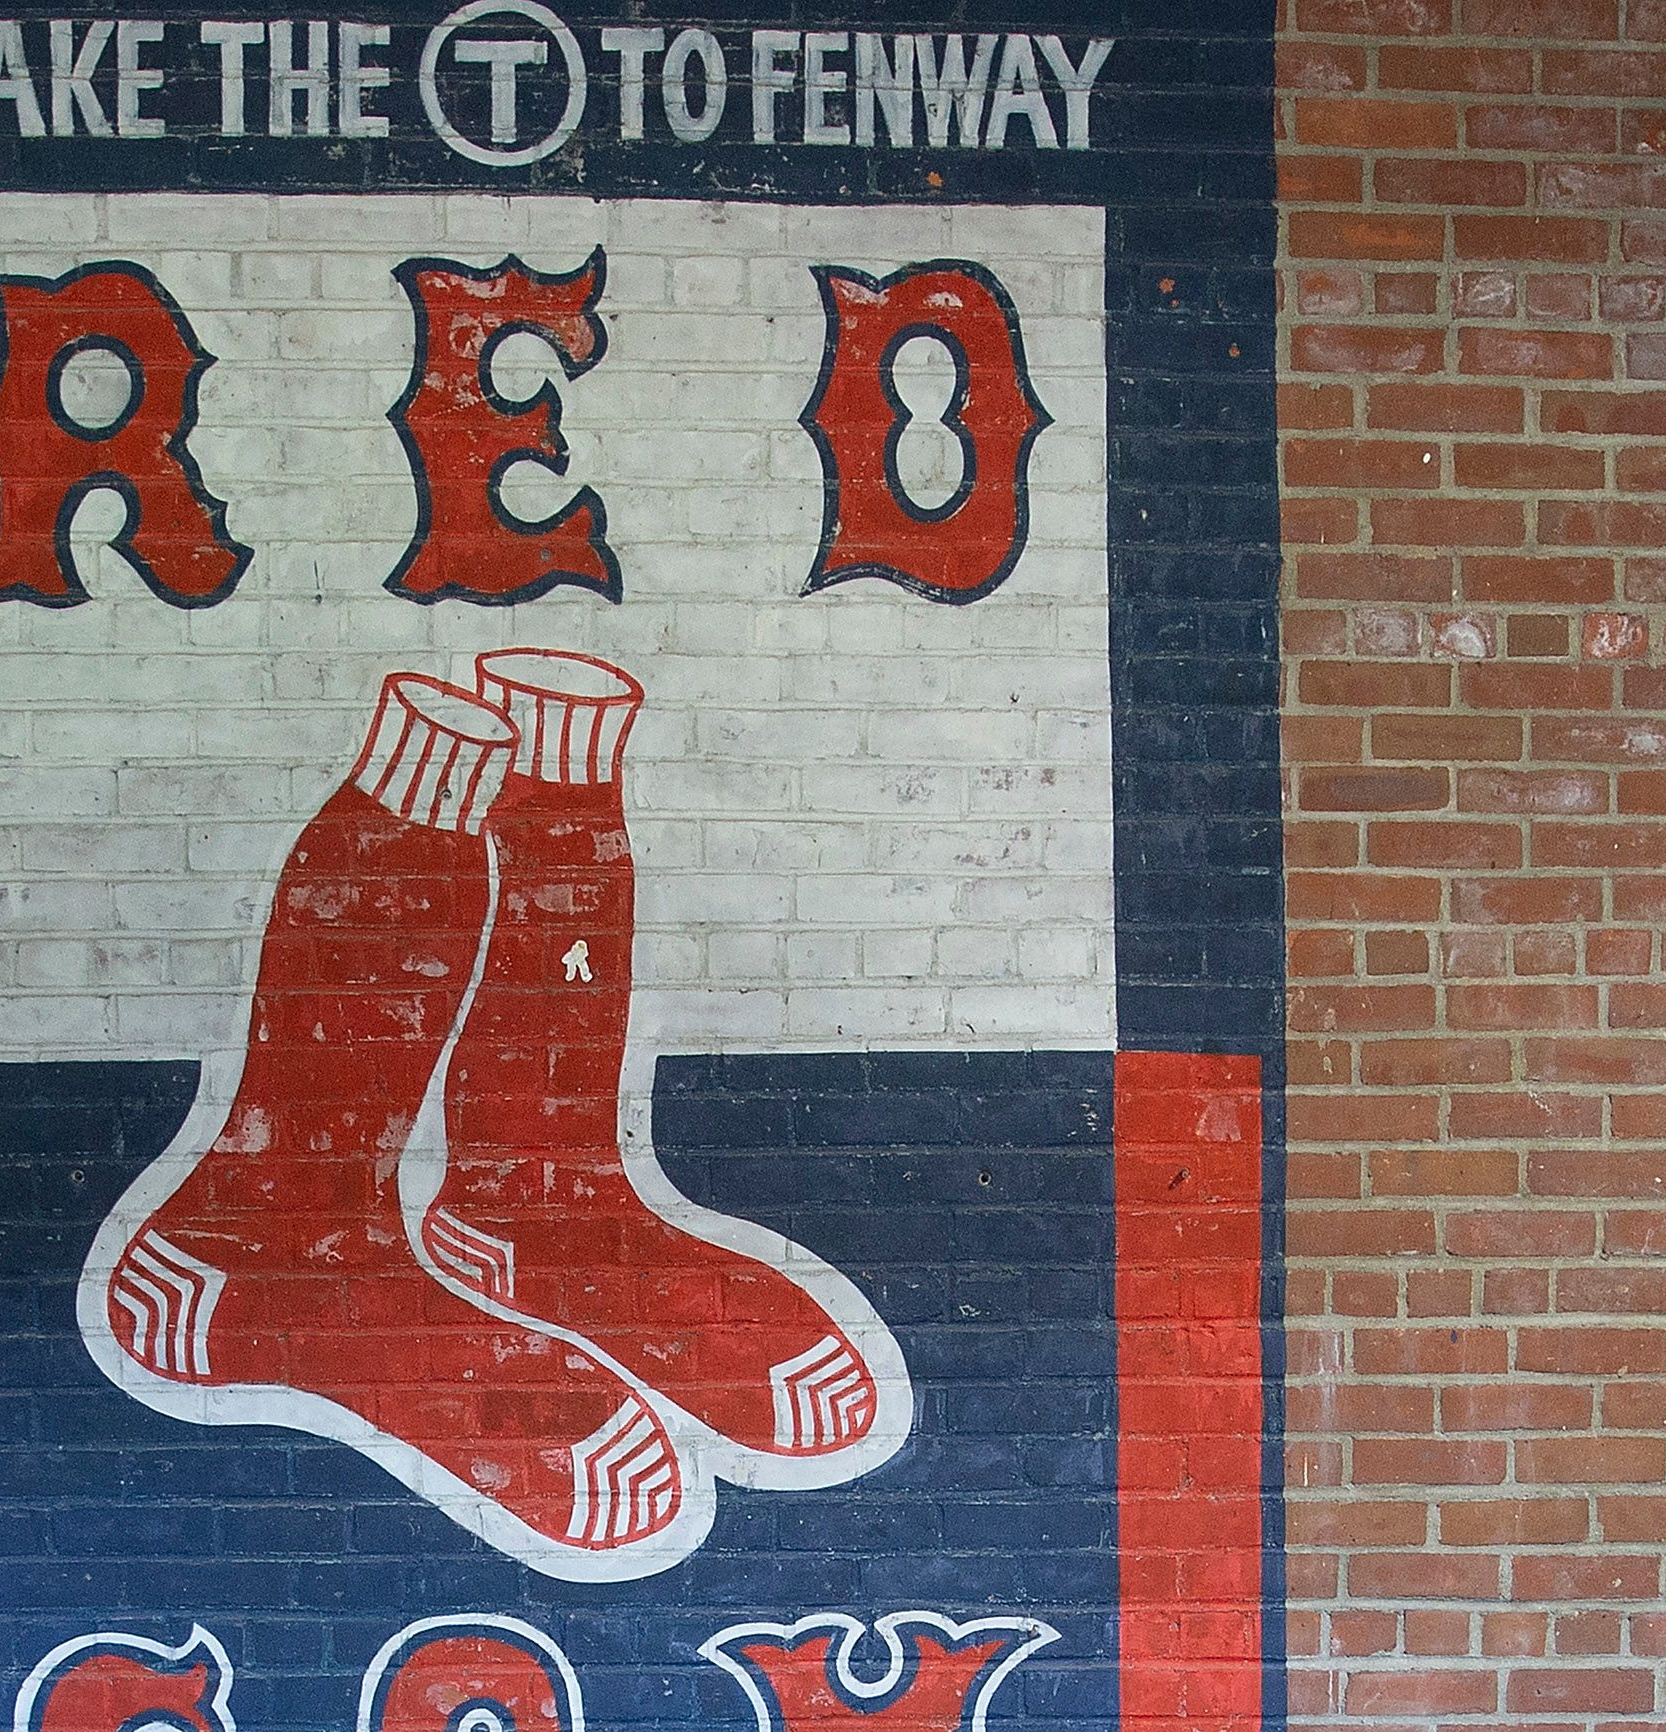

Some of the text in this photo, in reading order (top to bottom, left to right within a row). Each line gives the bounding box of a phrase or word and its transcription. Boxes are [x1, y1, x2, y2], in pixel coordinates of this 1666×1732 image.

[199, 20, 391, 138] THE
[600, 27, 728, 142] TO
[751, 29, 1117, 150] FENWAY
